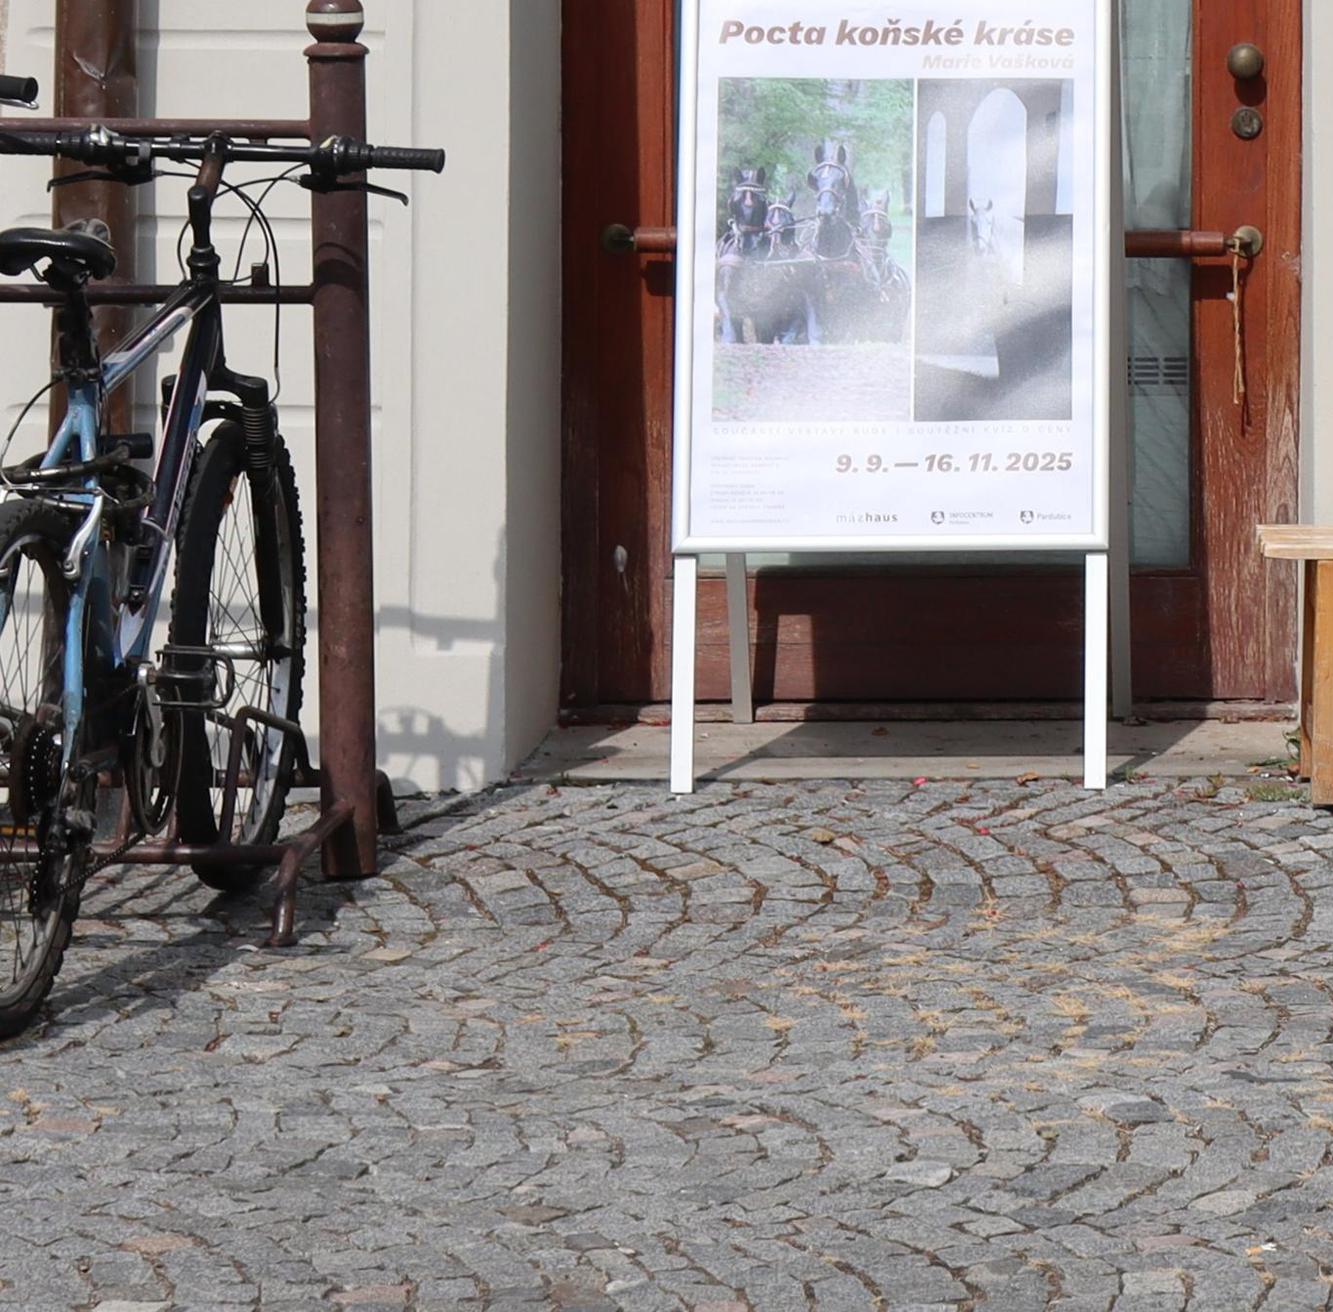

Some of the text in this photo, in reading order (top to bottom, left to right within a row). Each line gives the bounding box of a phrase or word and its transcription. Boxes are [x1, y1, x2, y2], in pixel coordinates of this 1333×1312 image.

[719, 18, 1075, 47] Pocta koňské kráse
[922, 51, 1075, 70] Marie Vašková
[836, 453, 859, 474] 9.
[866, 453, 890, 473] 9.
[925, 453, 960, 473] 16.
[968, 452, 999, 473] 11.
[1005, 451, 1073, 473] 2025
[836, 511, 899, 524] mázhaus
